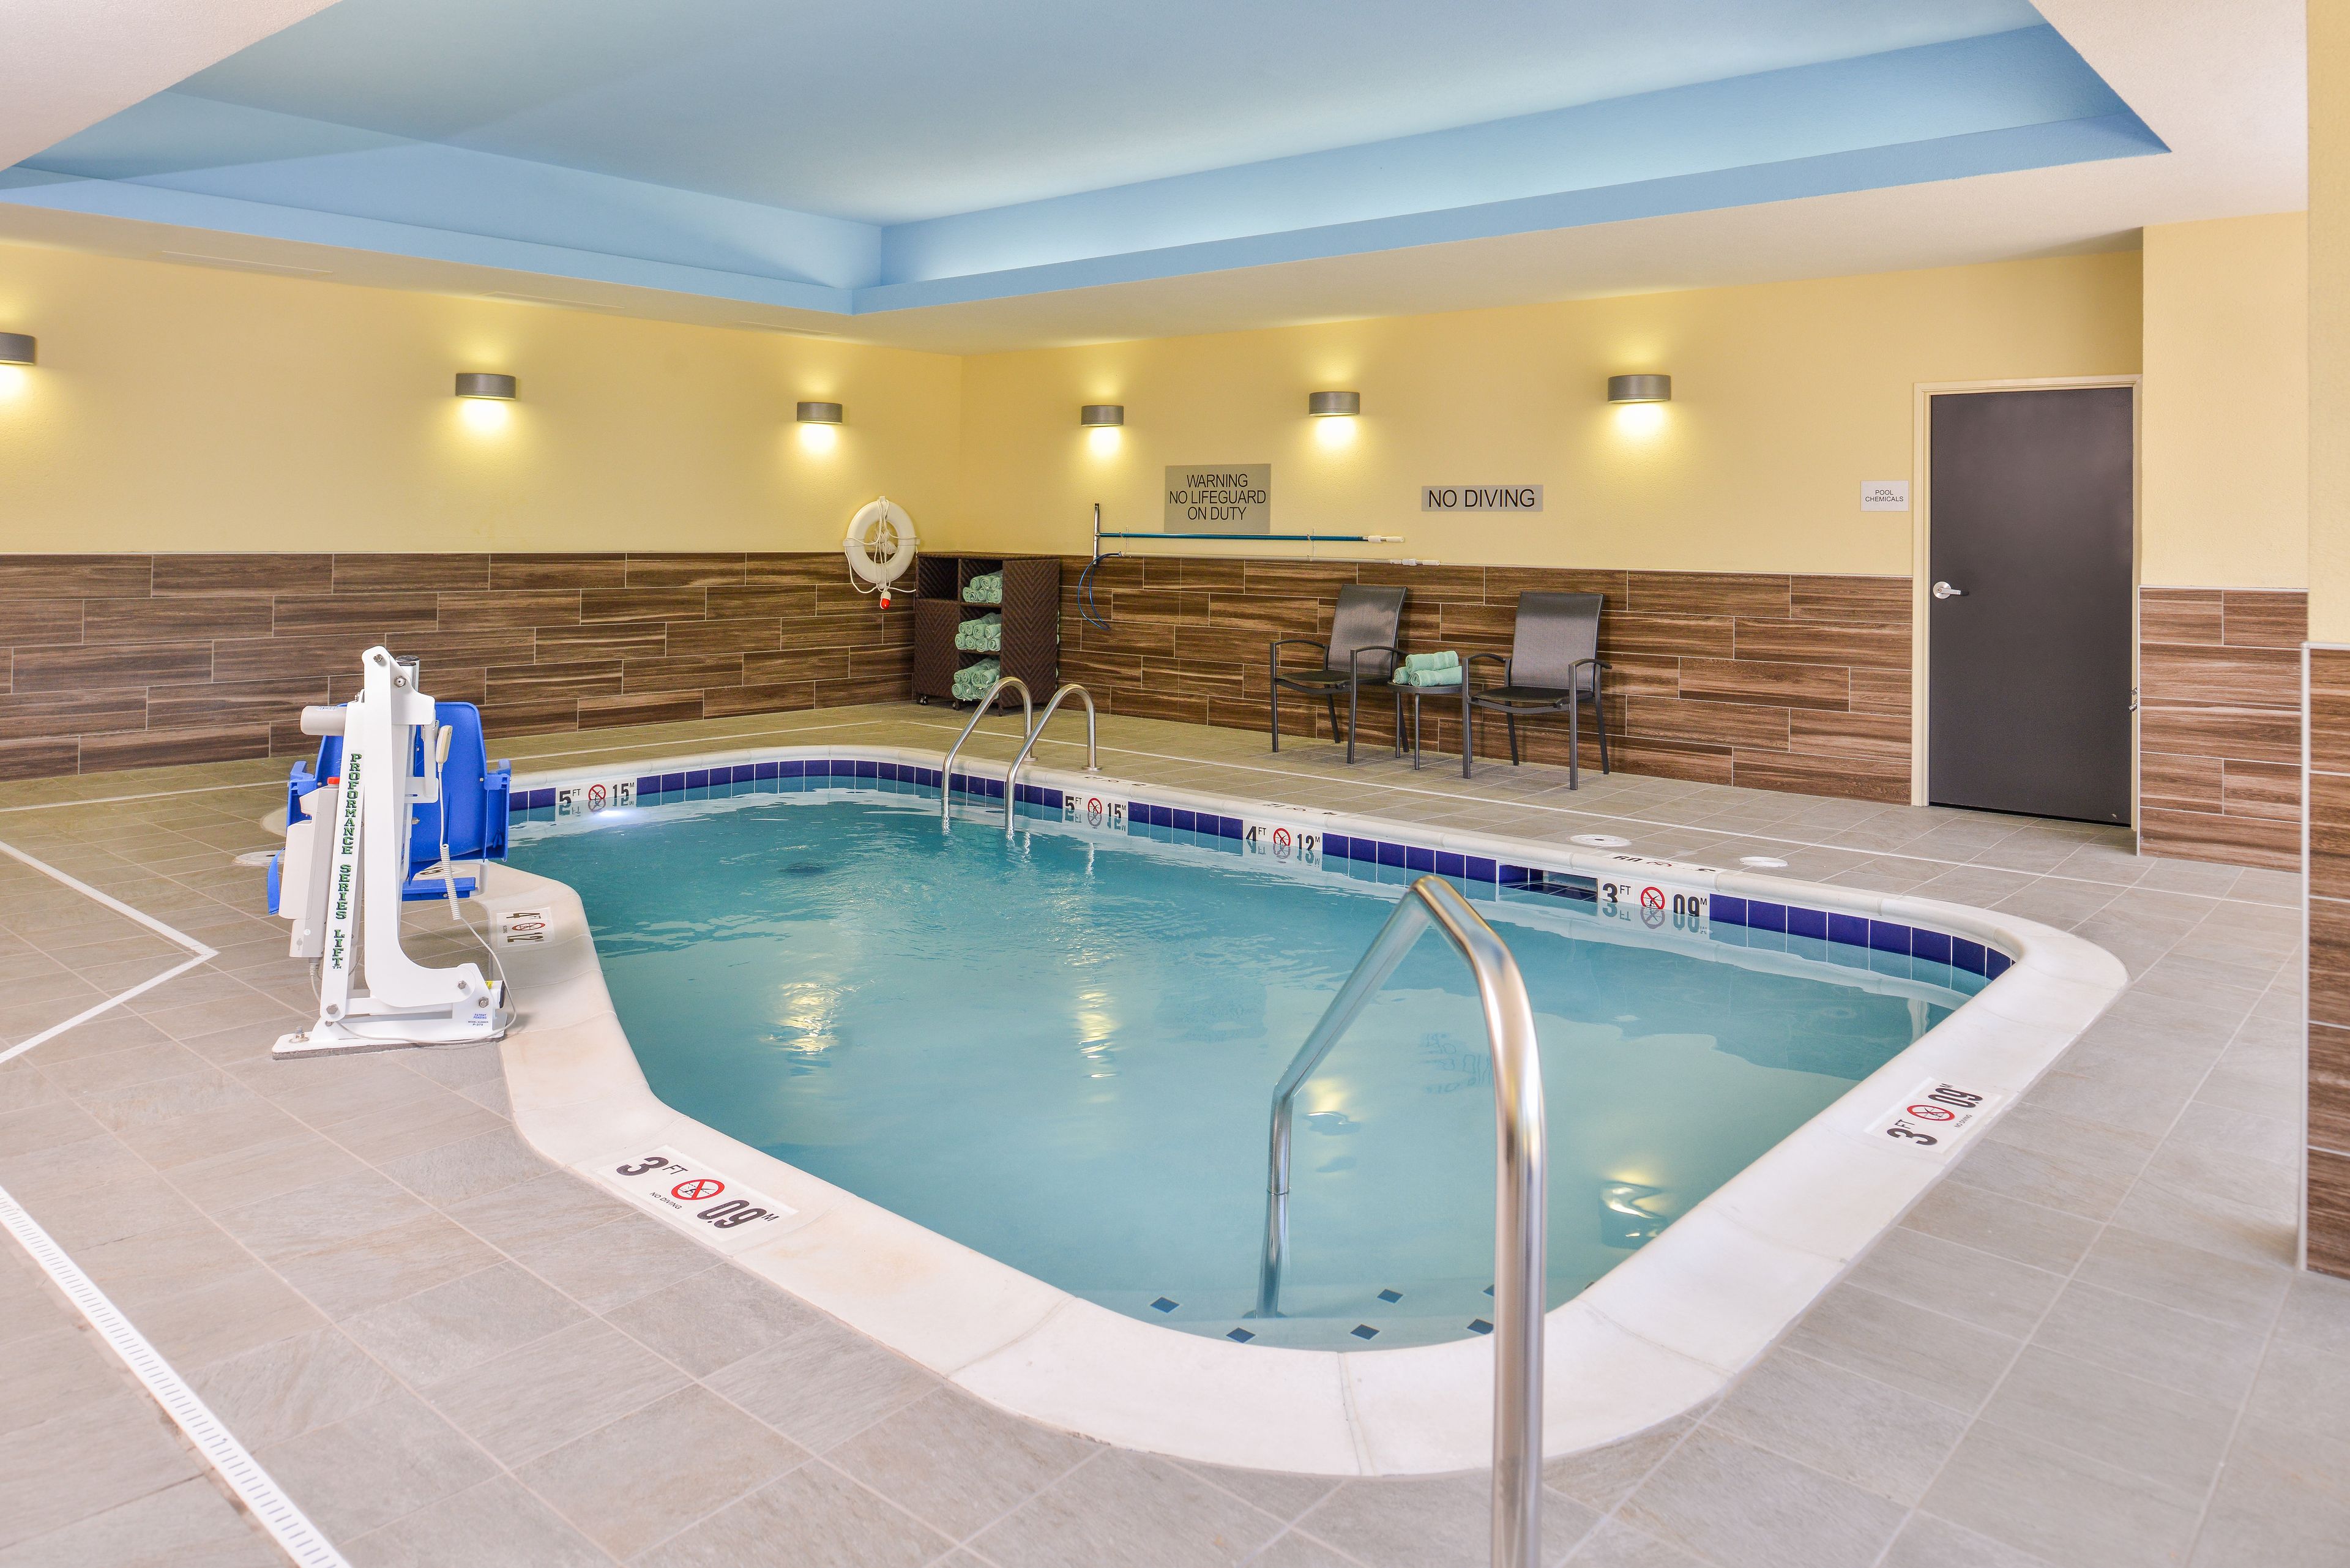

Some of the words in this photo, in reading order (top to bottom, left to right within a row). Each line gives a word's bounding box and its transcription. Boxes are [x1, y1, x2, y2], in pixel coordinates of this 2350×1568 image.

[1187, 473, 1248, 488] WARNING
[1169, 490, 1188, 504] NO
[1191, 490, 1266, 504] LIFEGUARD
[1429, 489, 1457, 508] NO
[1464, 488, 1535, 507] DIVING
[1188, 506, 1207, 520] ON
[1210, 506, 1247, 520] DUTY
[341, 753, 362, 854] PROFORMANCE
[1258, 827, 1266, 835] FT
[335, 864, 352, 919] SERIES
[1602, 883, 1618, 903] 3
[1620, 885, 1631, 895] FT
[1700, 897, 1707, 906] M
[1895, 1119, 1915, 1129] FT
[1887, 1128, 1938, 1146] 3
[616, 1157, 670, 1176] 3
[662, 1164, 688, 1175] FT
[696, 1200, 767, 1229] 0.9
[761, 1213, 780, 1222] M
[660, 1197, 682, 1209] DIVING
